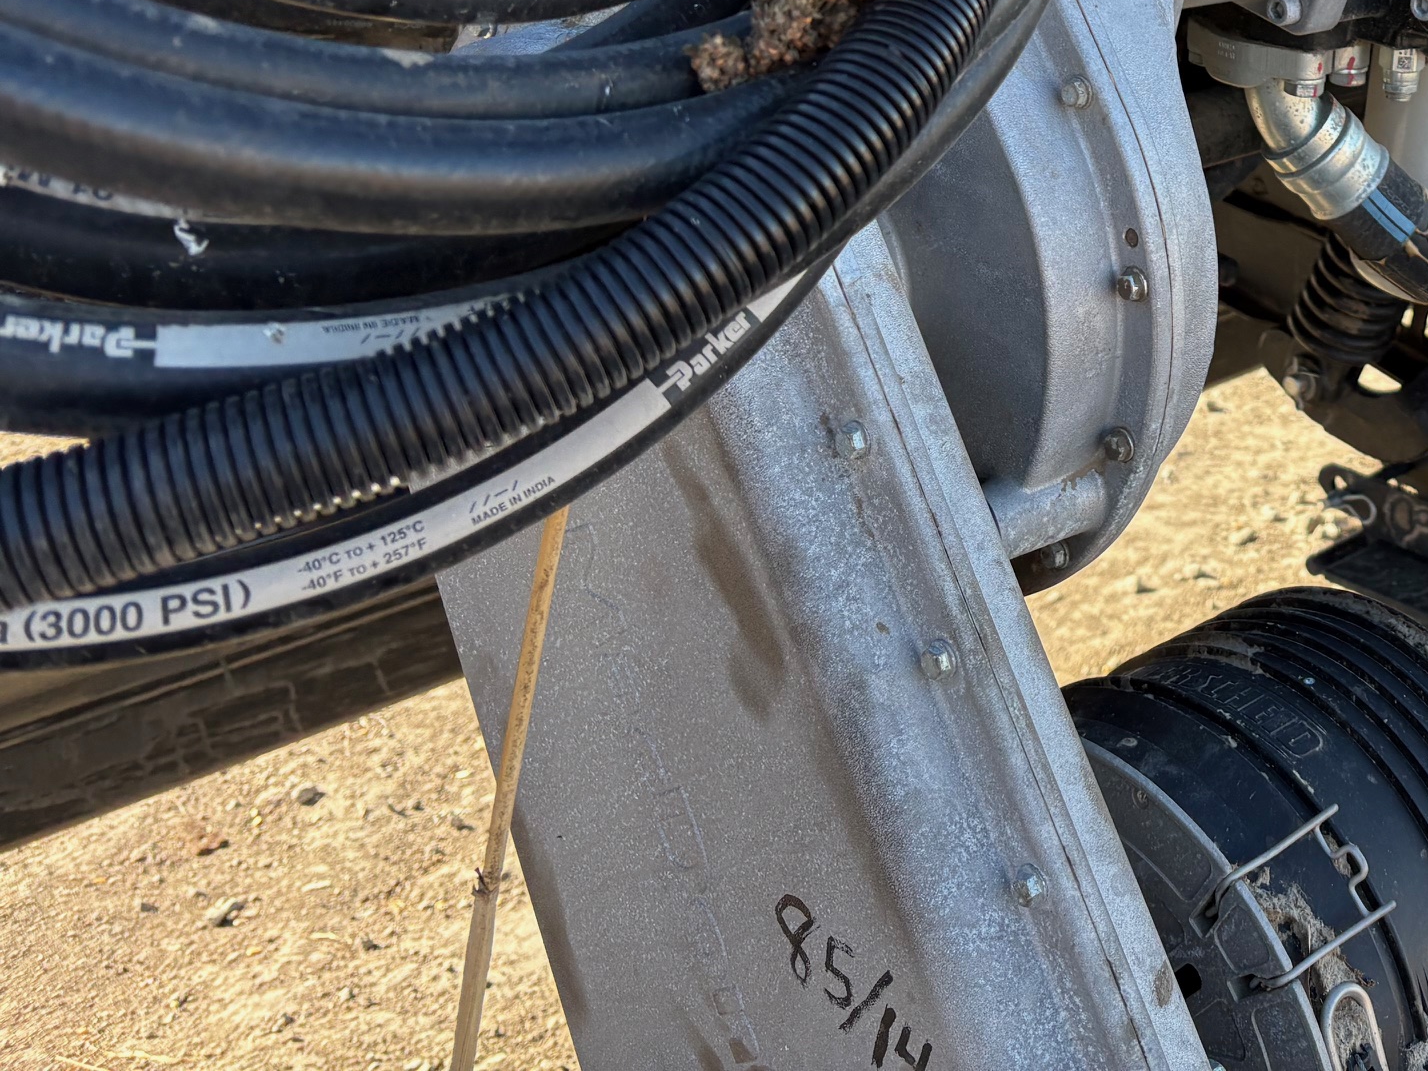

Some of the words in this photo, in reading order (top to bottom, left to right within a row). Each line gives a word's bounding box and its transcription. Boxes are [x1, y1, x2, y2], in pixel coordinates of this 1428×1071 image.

[1, 313, 136, 358] Parker
[665, 310, 752, 392] Parker
[471, 503, 508, 527] MADE
[508, 495, 523, 507] IN
[523, 476, 556, 500] INDIA
[297, 551, 341, 575] -40°C
[345, 545, 364, 560] TO
[366, 542, 375, 552] +
[380, 520, 425, 547] 125°C
[301, 569, 344, 593] -40°F
[348, 564, 367, 579] TO
[370, 561, 379, 570] +
[383, 537, 428, 565] 257°F
[24, 601, 144, 643] (3000
[160, 579, 252, 626] PSI)
[774, 893, 933, 1071] 85/14
